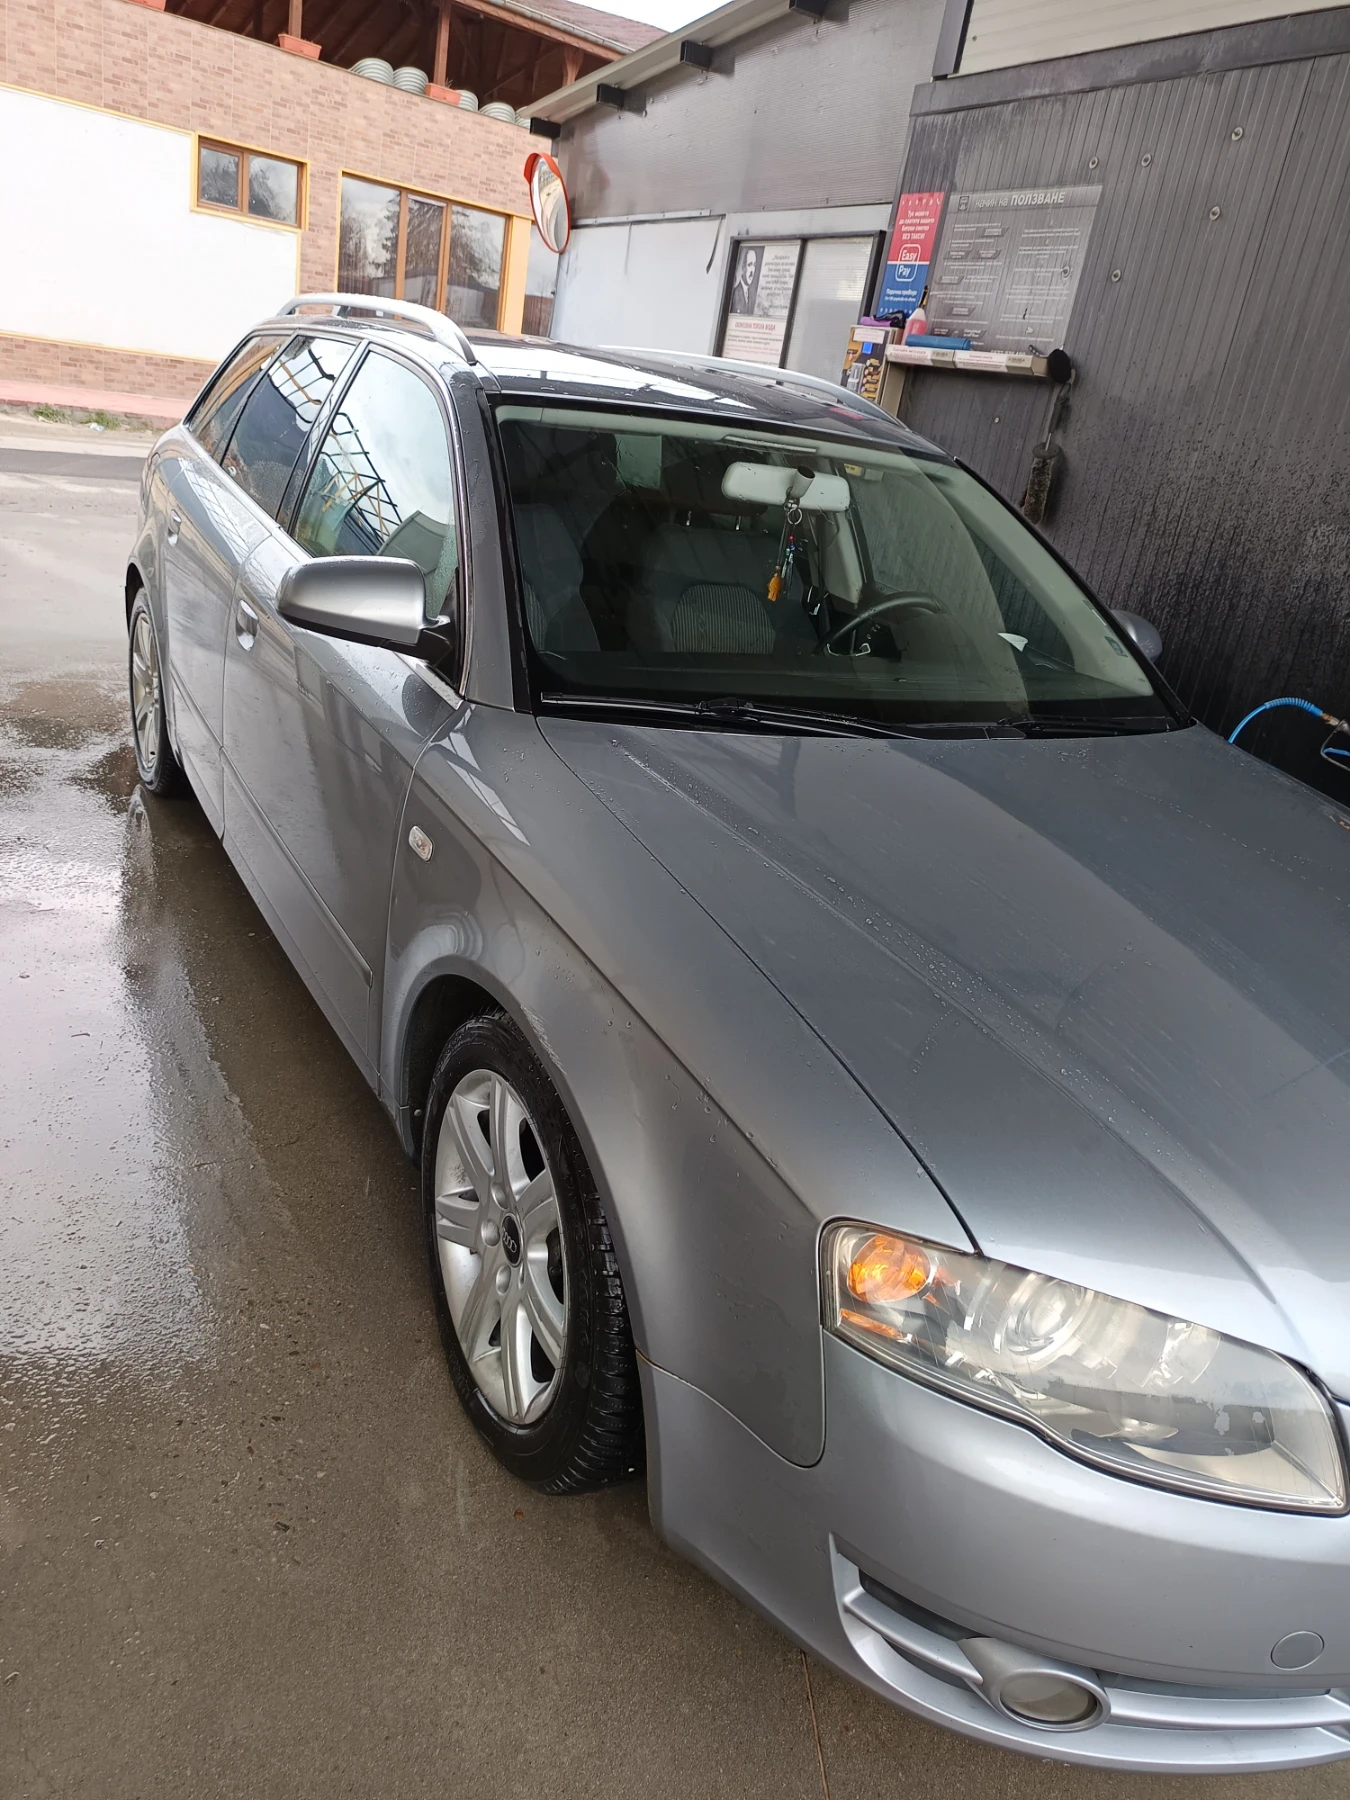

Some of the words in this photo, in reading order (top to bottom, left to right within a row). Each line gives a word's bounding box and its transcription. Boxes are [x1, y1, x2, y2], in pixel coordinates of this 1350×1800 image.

[999, 197, 1008, 207] на
[1010, 192, 1066, 206] ПОЛЗВАНЕ
[901, 250, 917, 262] Easy
[898, 264, 911, 277] Pay
